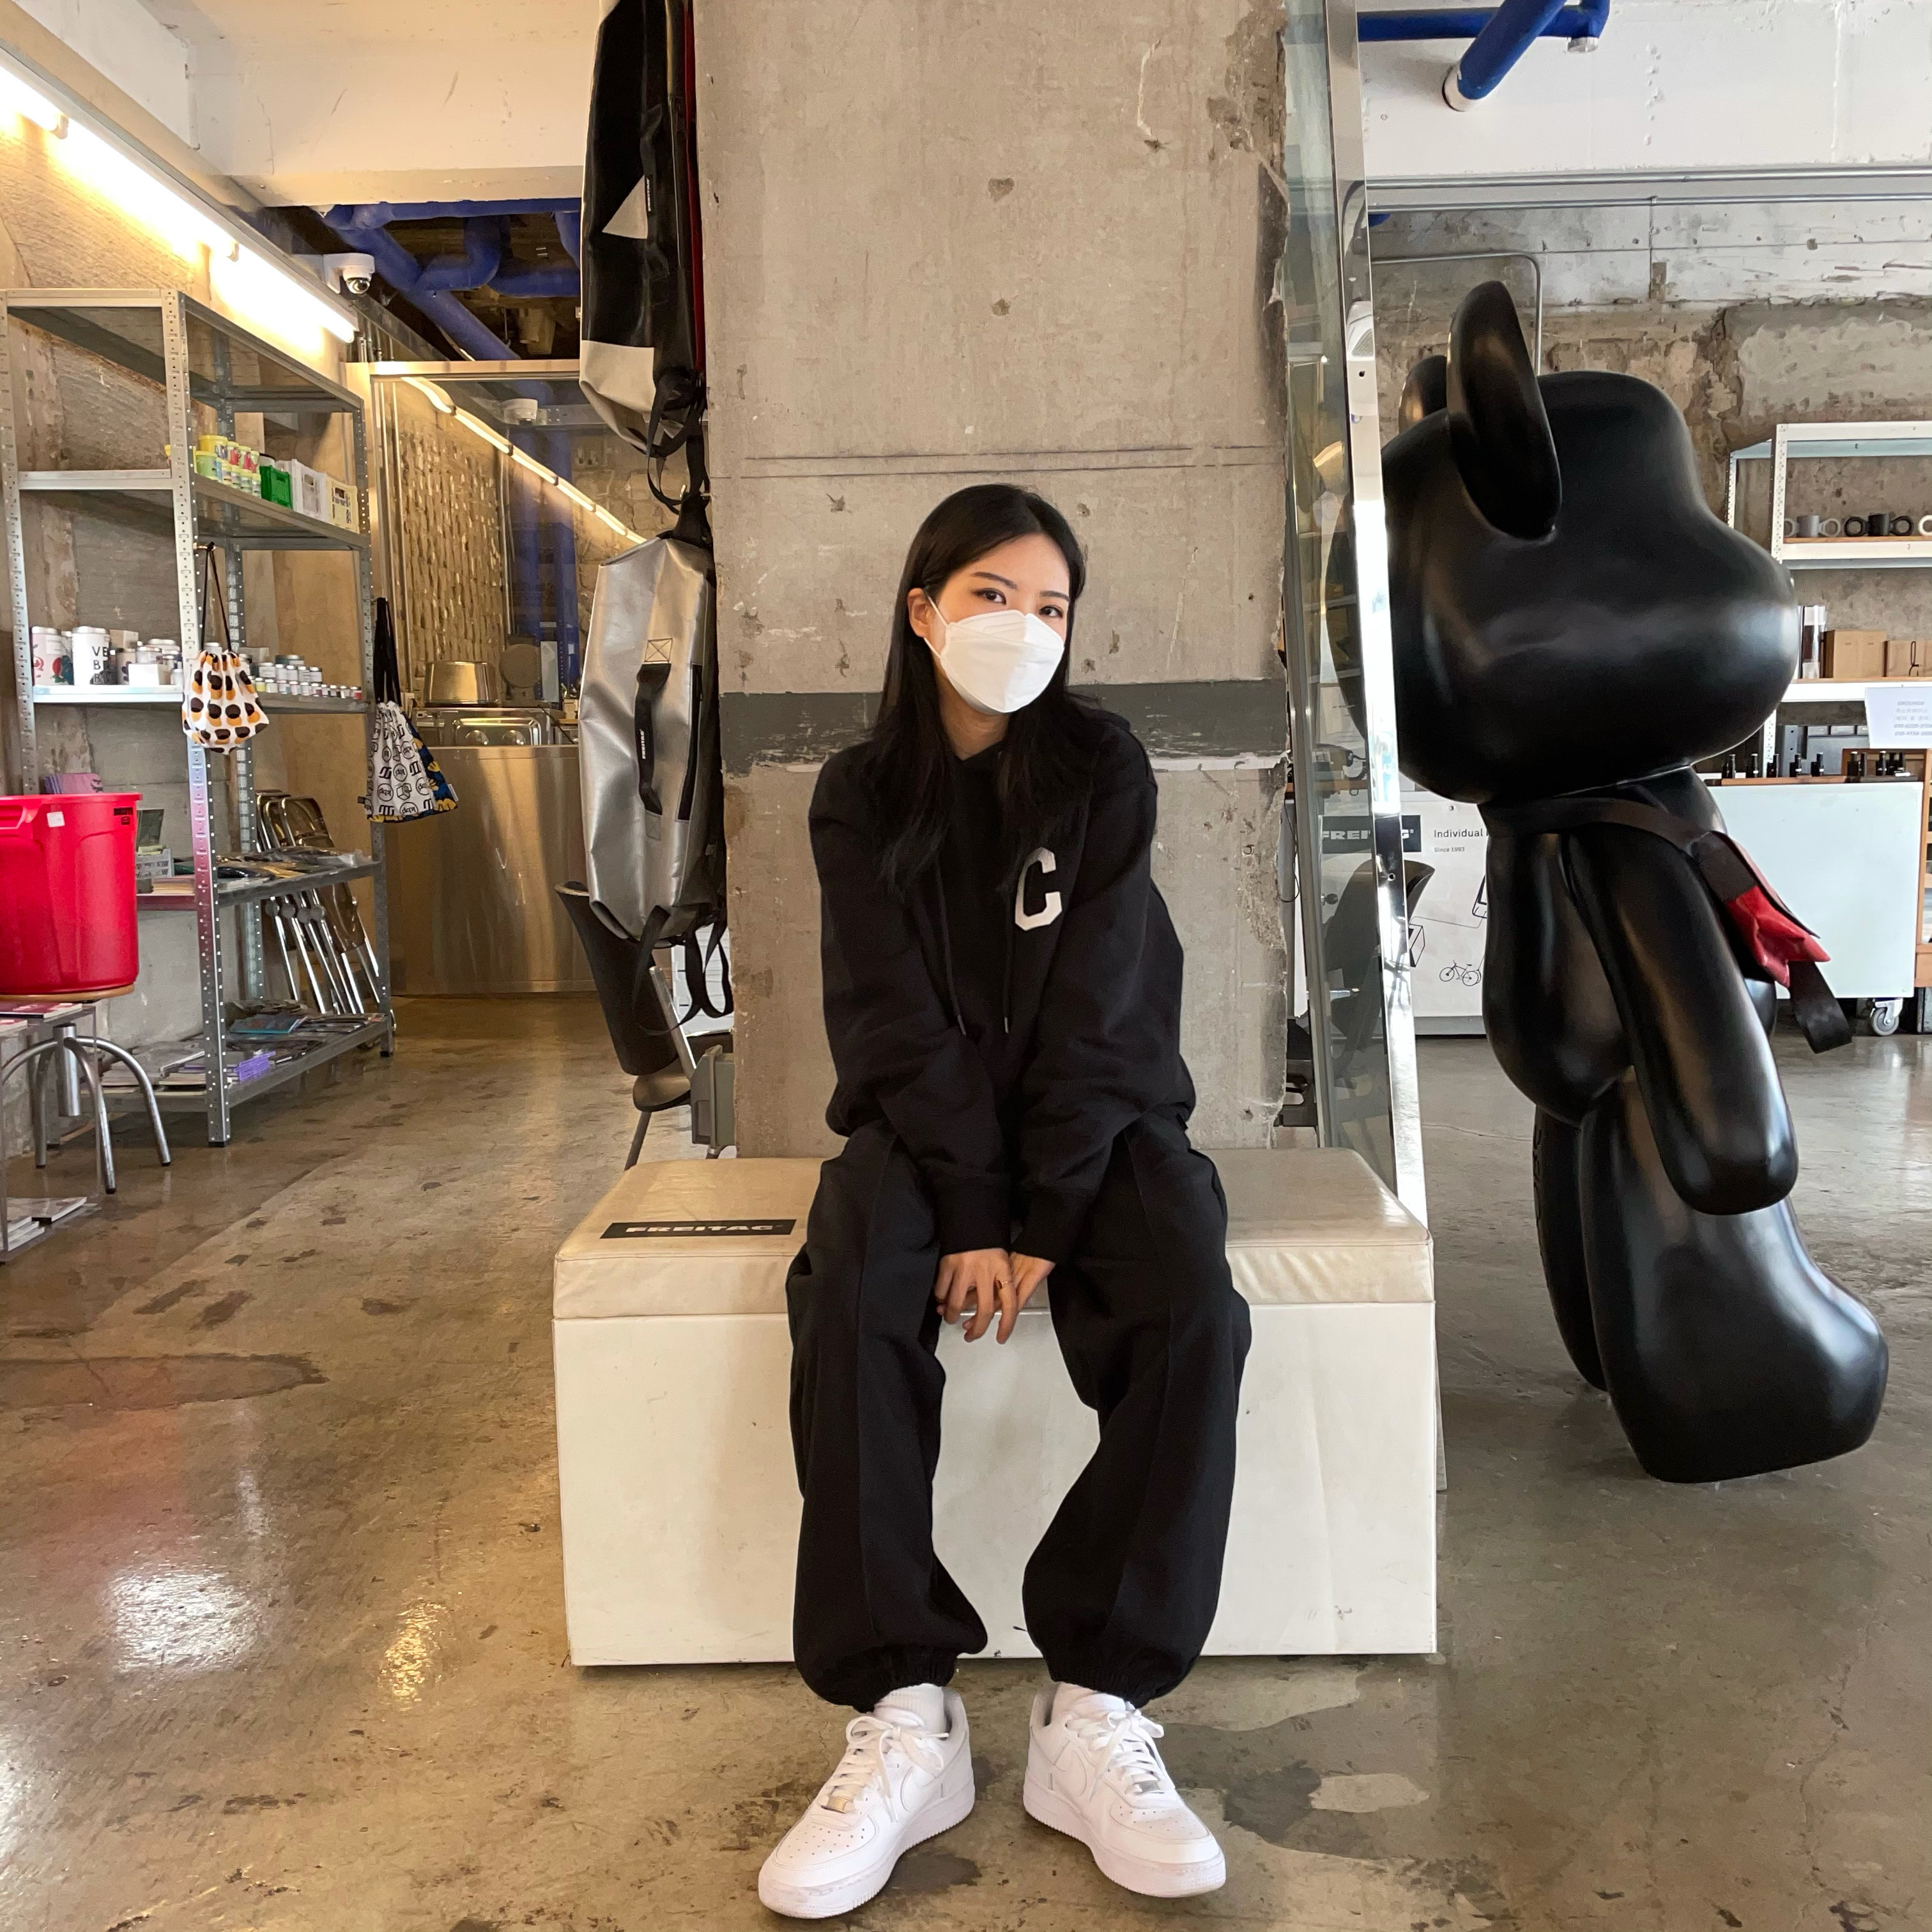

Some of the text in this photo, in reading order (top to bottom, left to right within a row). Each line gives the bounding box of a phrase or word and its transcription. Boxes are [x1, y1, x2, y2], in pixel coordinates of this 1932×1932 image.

[1434, 828, 1483, 838] Individual
[1015, 847, 1062, 931] C
[625, 1225, 774, 1233] FREITAG
